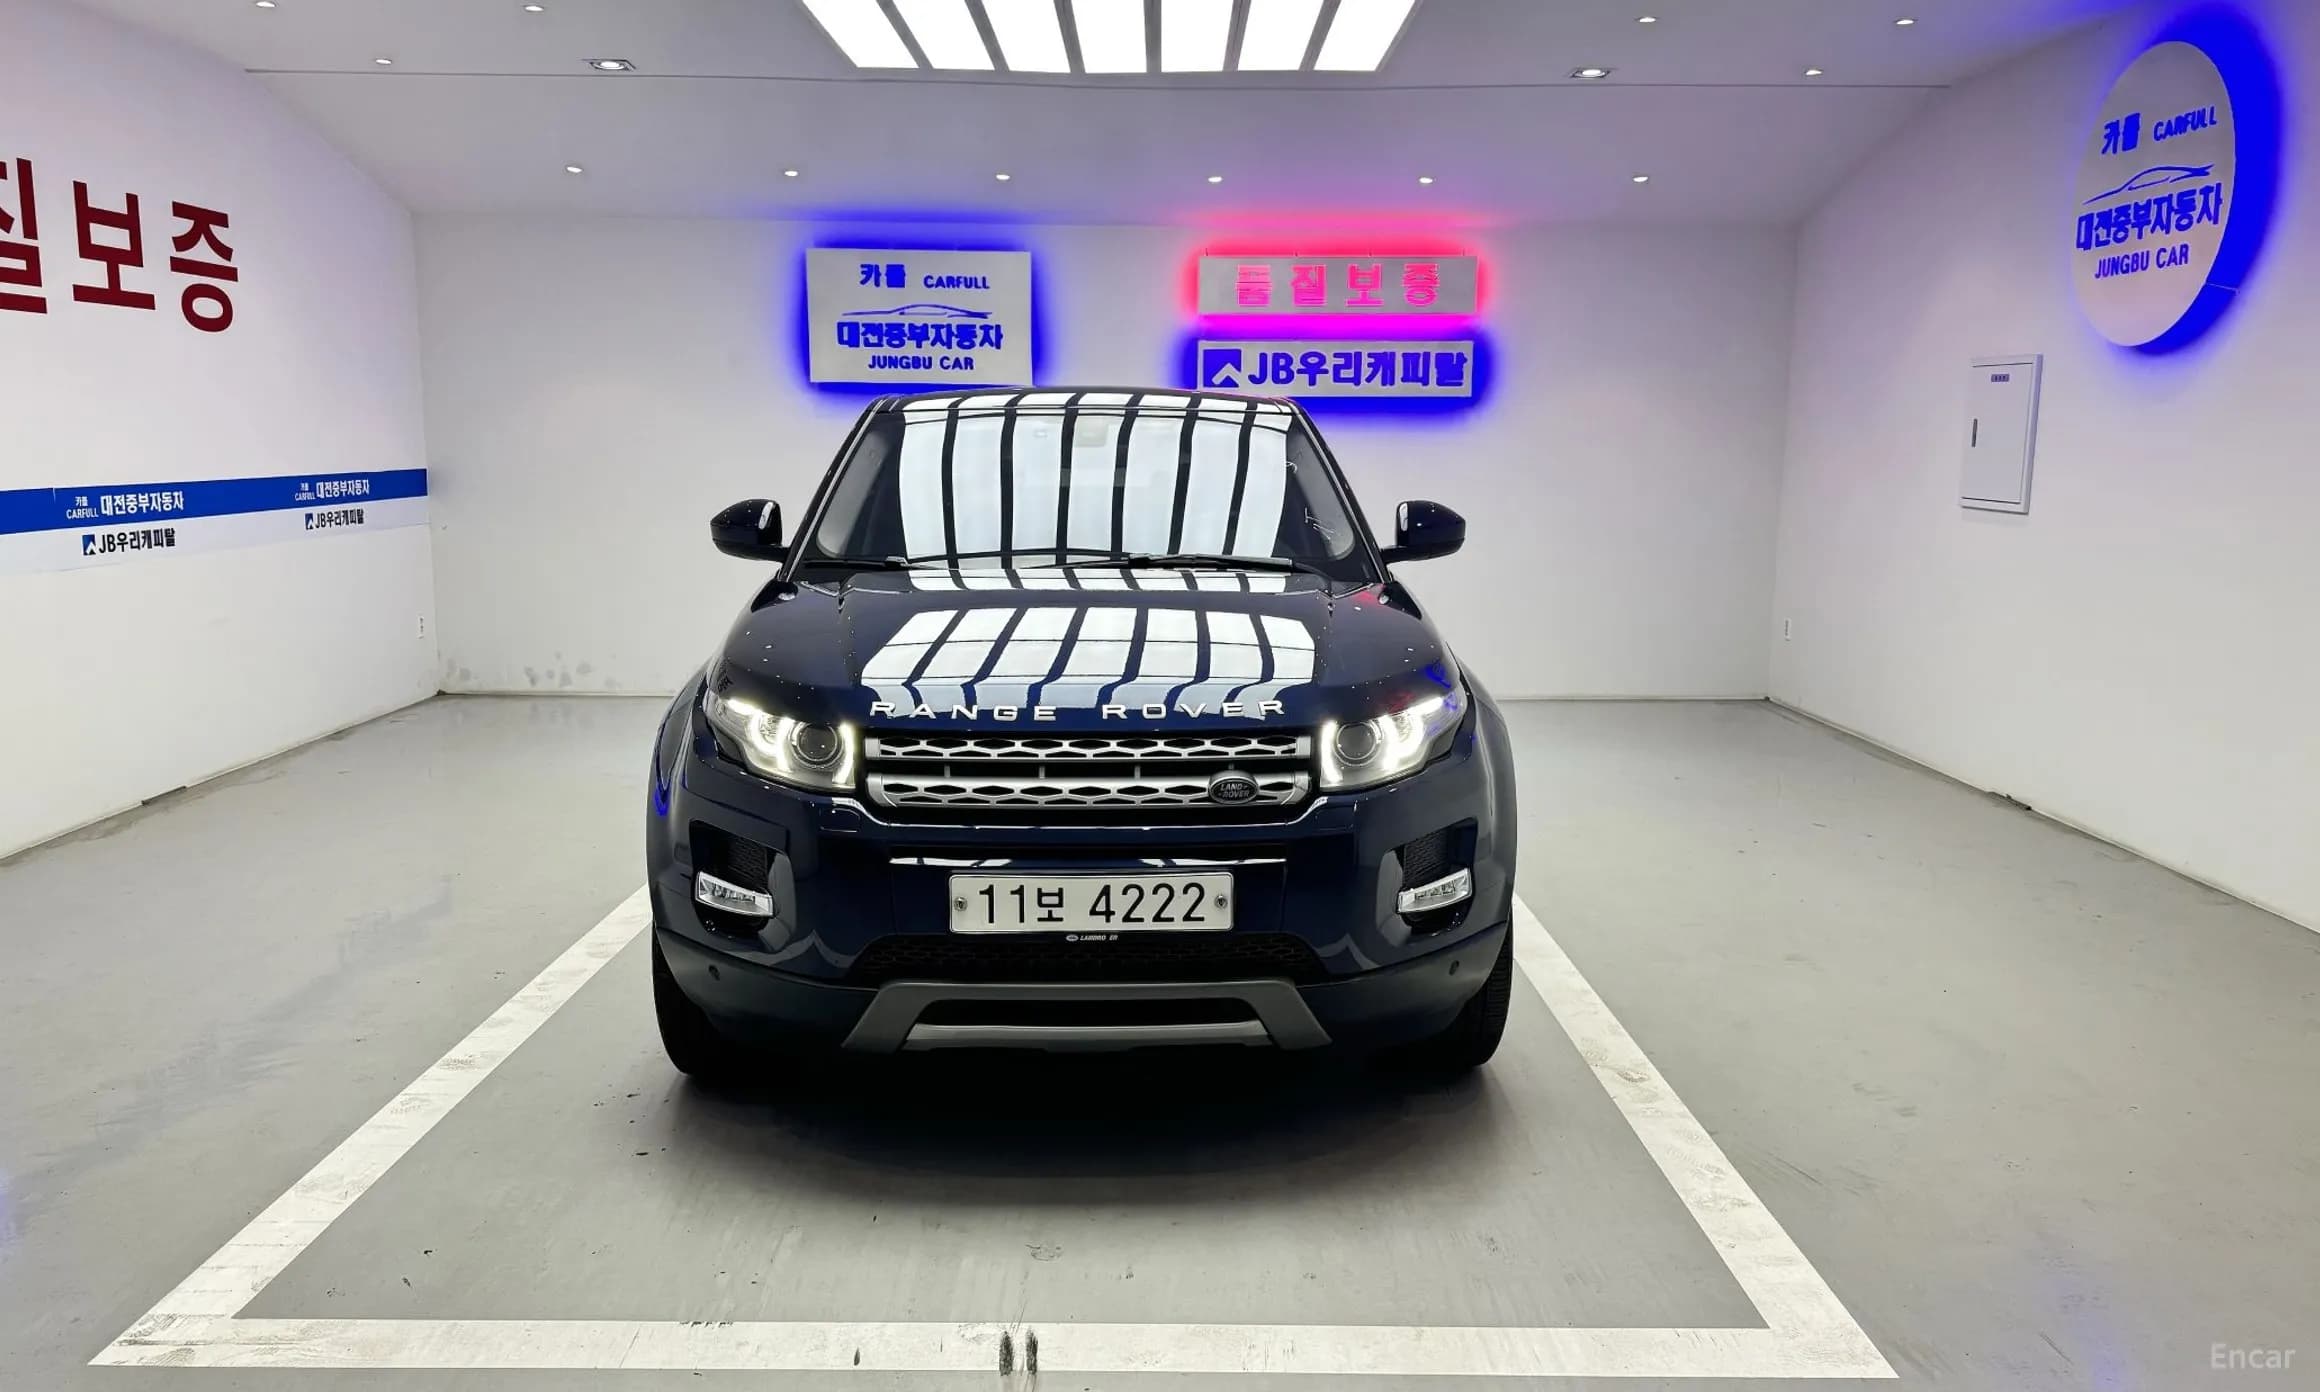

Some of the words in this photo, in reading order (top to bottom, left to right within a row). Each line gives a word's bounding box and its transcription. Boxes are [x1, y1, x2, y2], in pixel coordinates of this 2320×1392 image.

[2153, 106, 2217, 142] CARFULL
[2094, 250, 2150, 279] JUNGBU
[2155, 243, 2189, 269] CAR
[923, 274, 990, 290] CARFULL
[836, 321, 1003, 350] 대전중부자동차
[868, 355, 932, 370] JUNGBU
[939, 356, 975, 371] CAR
[1247, 351, 1468, 387] JB우리캐피탈
[66, 507, 99, 519] CARFULL
[100, 491, 184, 516] 대전중부자동차
[315, 508, 364, 529] JB우리캐피탈
[98, 527, 176, 554] JB우리캐피탈
[869, 701, 1057, 721] RANGE
[1101, 700, 1285, 720] ROVER
[1220, 783, 1242, 791] LAND
[1222, 790, 1249, 799] ROVER
[979, 884, 1064, 924] 11보
[1089, 882, 1206, 923] 4222
